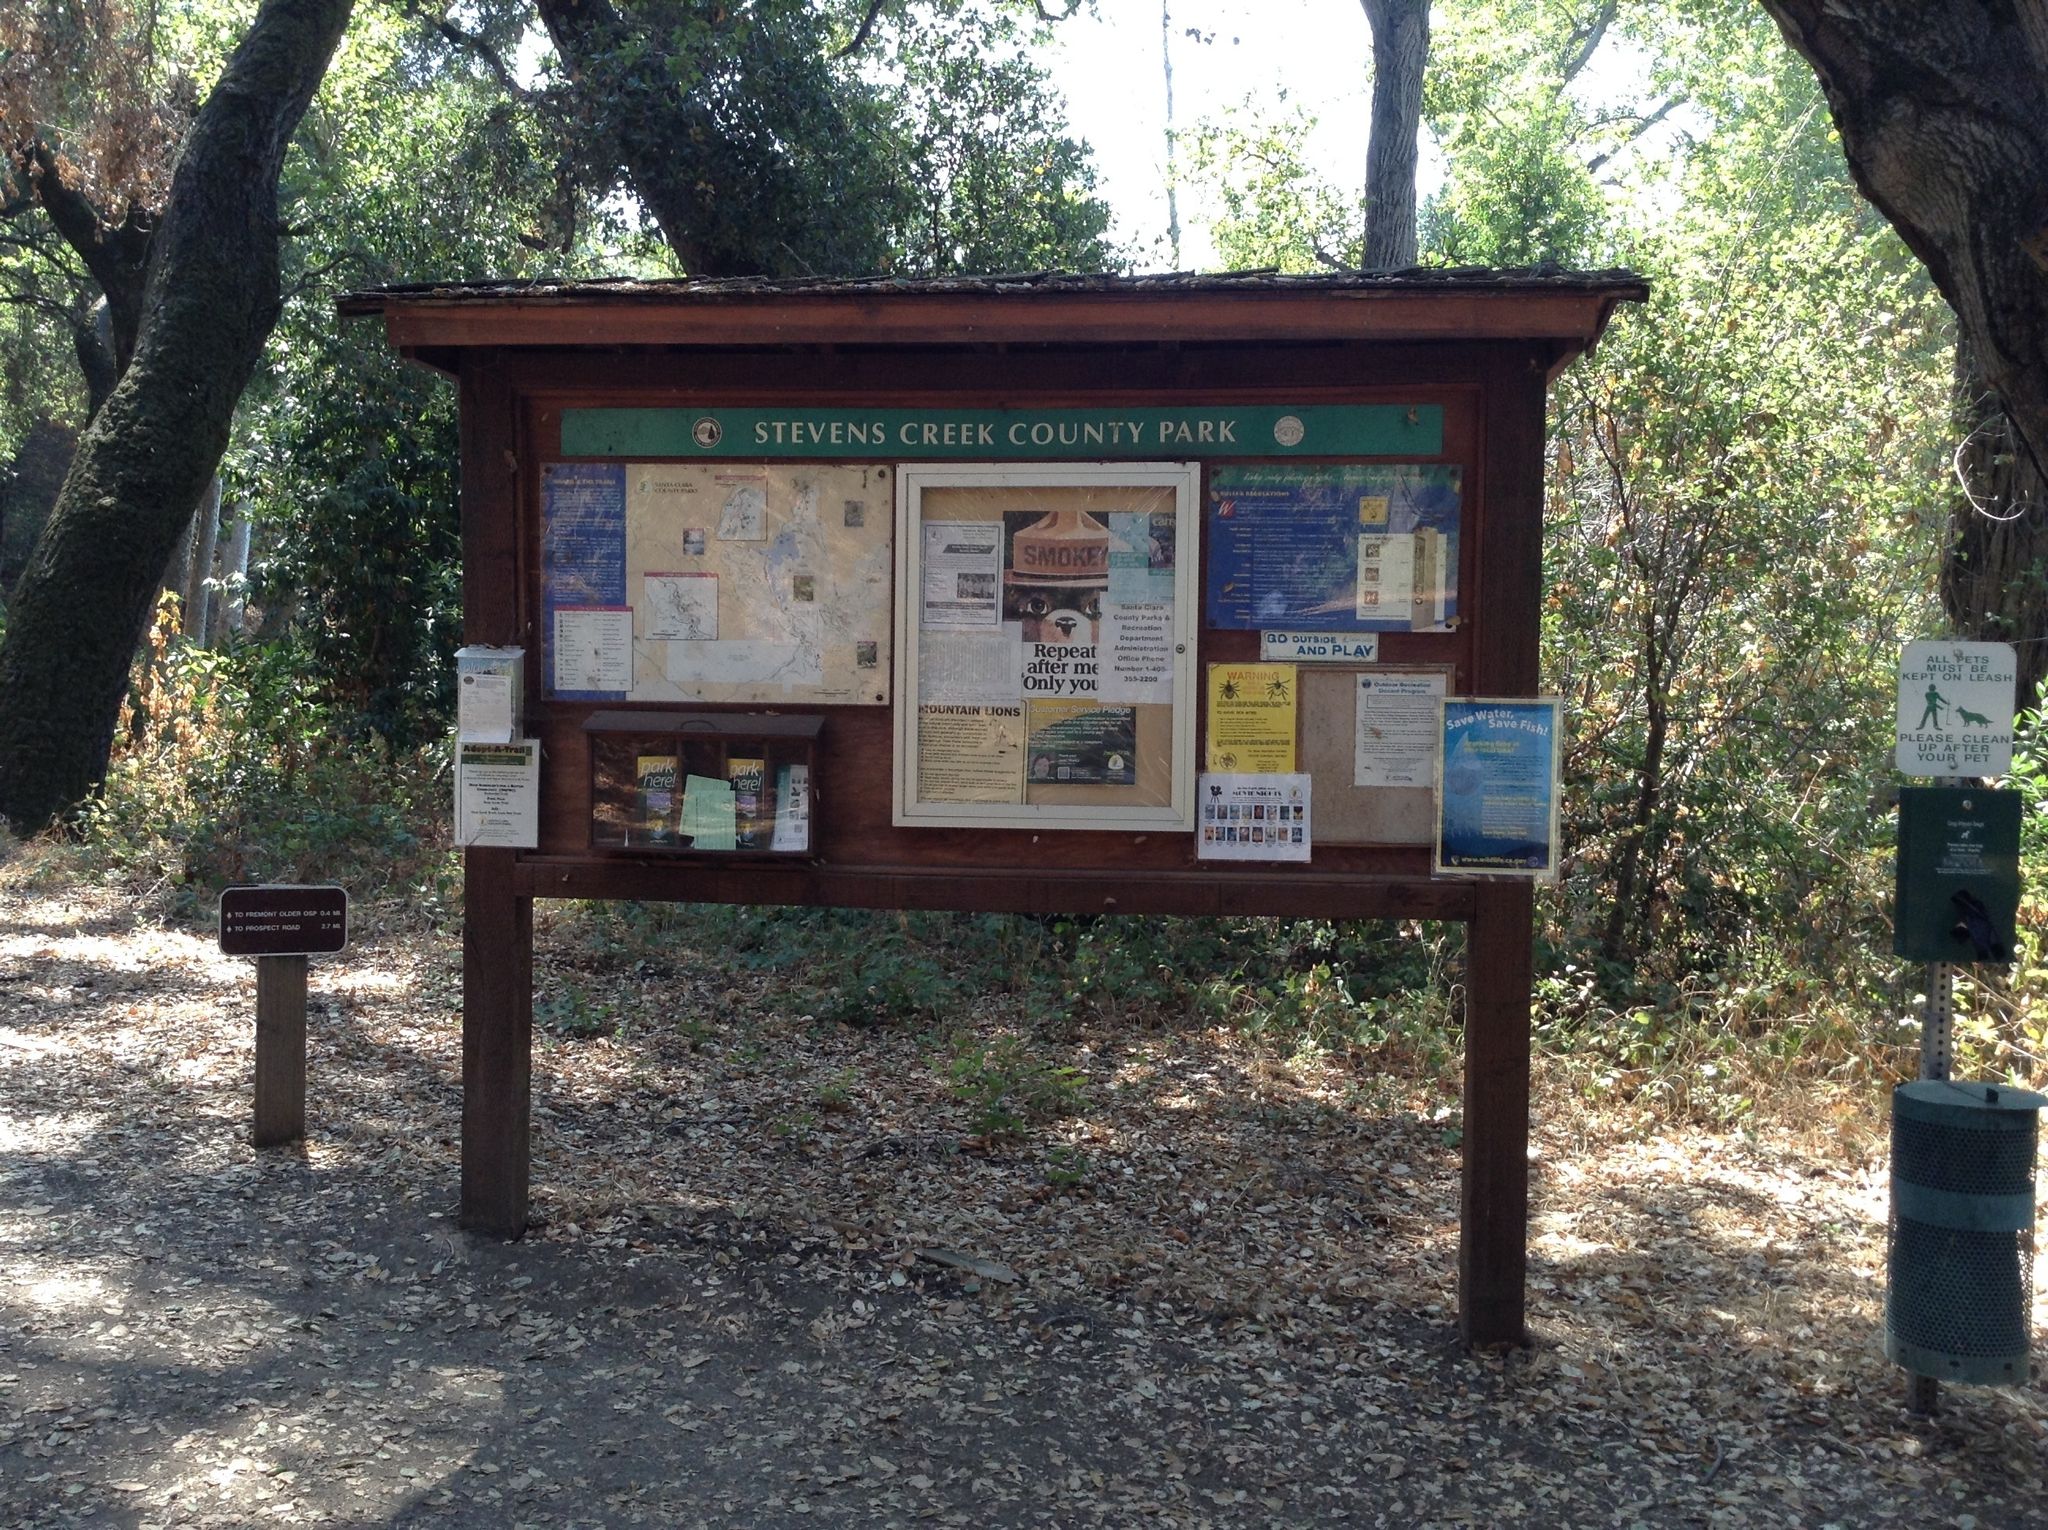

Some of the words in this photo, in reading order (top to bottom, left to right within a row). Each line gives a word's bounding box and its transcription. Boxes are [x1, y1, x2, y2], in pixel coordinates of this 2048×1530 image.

[754, 422, 886, 444] STEVENS
[900, 422, 994, 445] CREEK
[1008, 422, 1144, 445] COUNTY
[1159, 420, 1236, 444] PARK
[1119, 635, 1163, 643] Department
[1267, 633, 1287, 644] GO
[1292, 635, 1337, 644] OUTSIDE
[1034, 644, 1097, 661] Repeat
[1296, 645, 1327, 656] AND
[1331, 644, 1374, 657] PLAY
[1927, 655, 1949, 664] ALL
[1956, 656, 1989, 664] PETS
[1028, 660, 1069, 675] after
[1926, 664, 1963, 672] MUST
[1971, 665, 1988, 673] BE
[1227, 671, 1280, 681] WARNING
[1902, 672, 1936, 681] KEPT
[1942, 673, 1962, 681] ON
[1969, 674, 2012, 682] LEASH
[918, 704, 980, 716] MOUNTAIN
[985, 706, 1021, 717] LIONS
[1102, 705, 1131, 715] Pledge
[1446, 714, 1475, 731] Save
[1475, 710, 1514, 722] Water,
[1488, 718, 1518, 729] Save
[1519, 719, 1549, 737] Fish!
[1900, 734, 1953, 742] PLEASE
[1962, 735, 2009, 744] CLEAN
[1918, 744, 1937, 752] UP
[1944, 744, 1989, 753] AFTER
[1917, 753, 1956, 762] YOUR
[1964, 754, 1991, 762] PET
[640, 760, 674, 778] park
[643, 773, 677, 788] here!
[732, 776, 762, 791] here!
